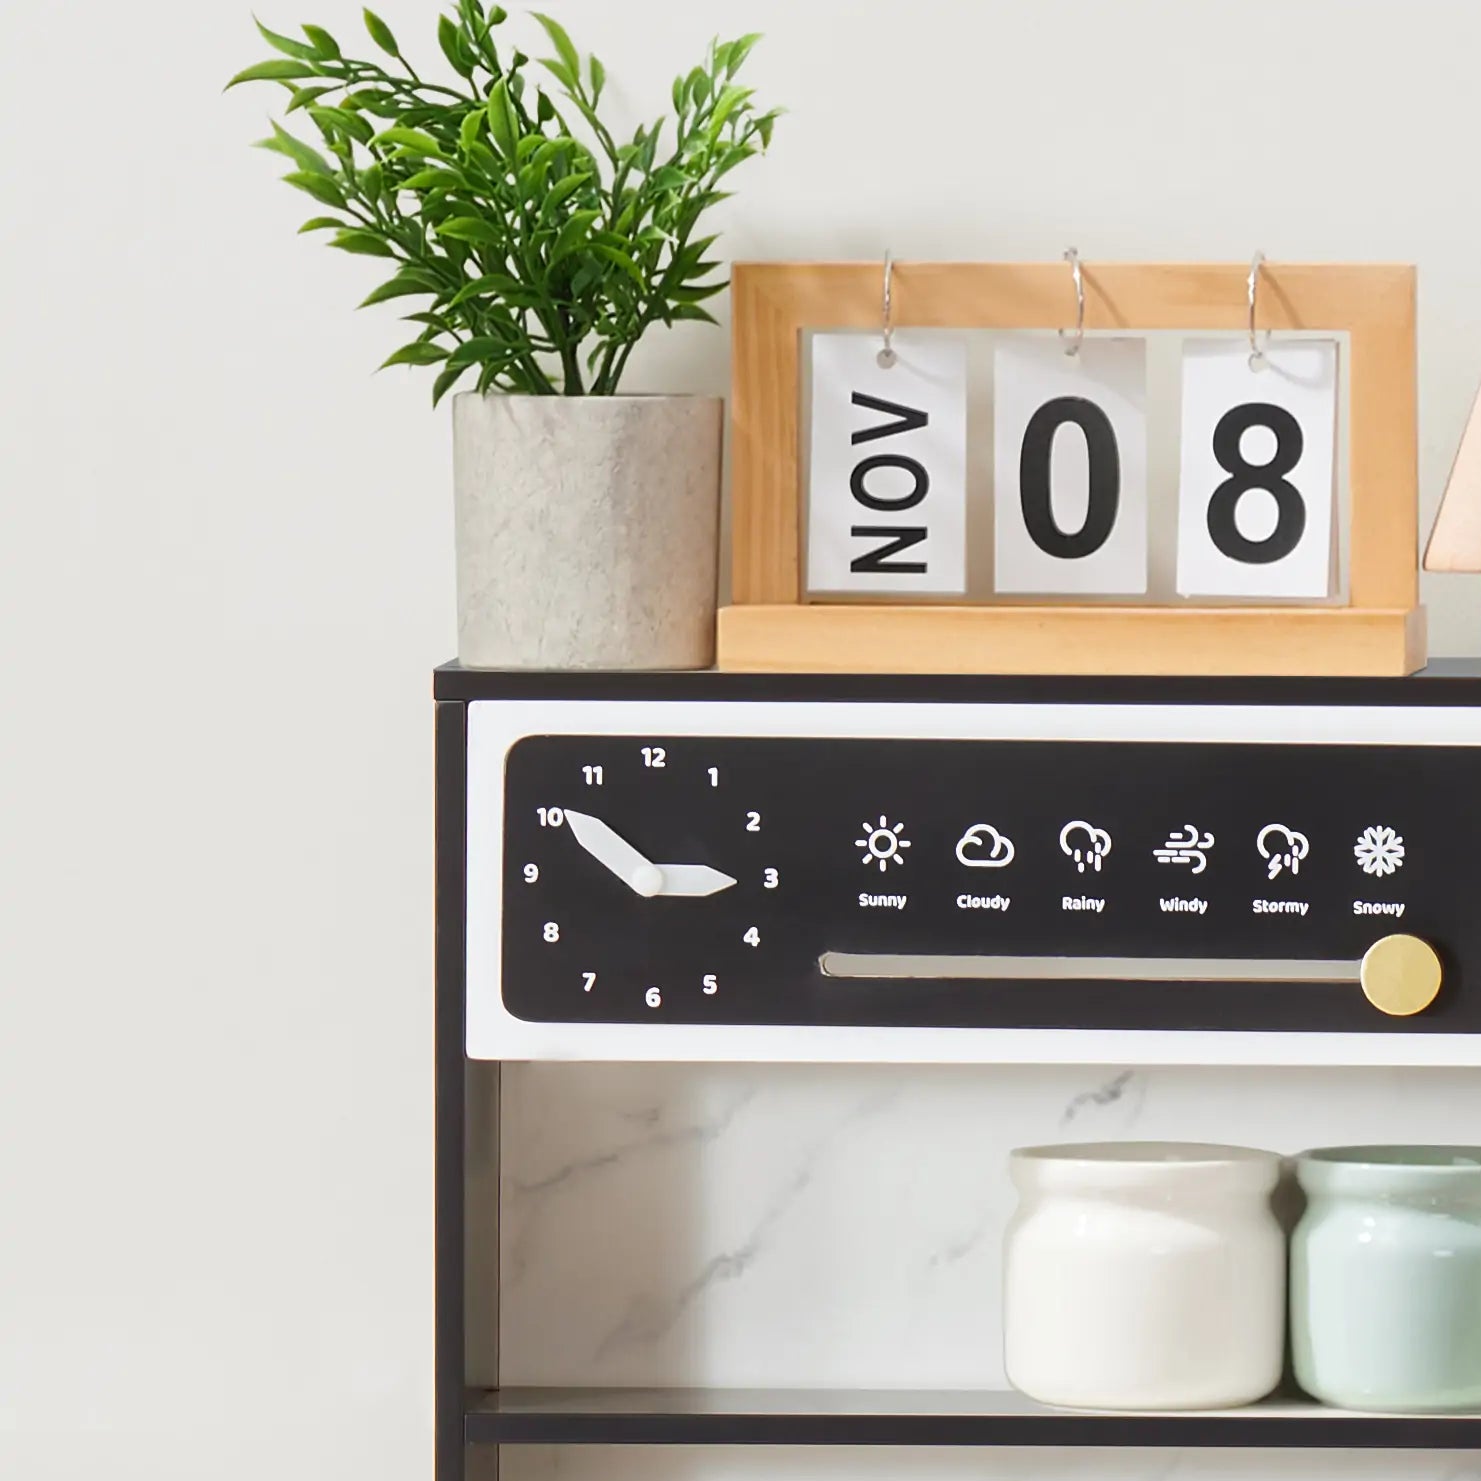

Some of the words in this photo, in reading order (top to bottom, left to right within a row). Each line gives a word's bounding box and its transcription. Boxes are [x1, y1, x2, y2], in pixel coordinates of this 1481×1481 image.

[849, 391, 930, 574] NOV
[640, 747, 666, 768] 12
[582, 765, 603, 786] 11
[707, 767, 719, 787] 1
[536, 806, 564, 827] 10
[745, 811, 761, 832] 2
[523, 863, 539, 884] 9
[763, 867, 779, 889] 3
[858, 892, 907, 910] Sunny
[956, 894, 1011, 912] Cloudy
[1062, 895, 1106, 913] Rainy
[1159, 896, 1208, 915] Windy
[1252, 899, 1310, 917] Stormy
[1353, 900, 1406, 918] Snowy
[543, 921, 560, 943] 8
[742, 926, 761, 947] 4
[582, 972, 597, 992] 7
[702, 974, 718, 995] 5
[645, 986, 662, 1008] 6
